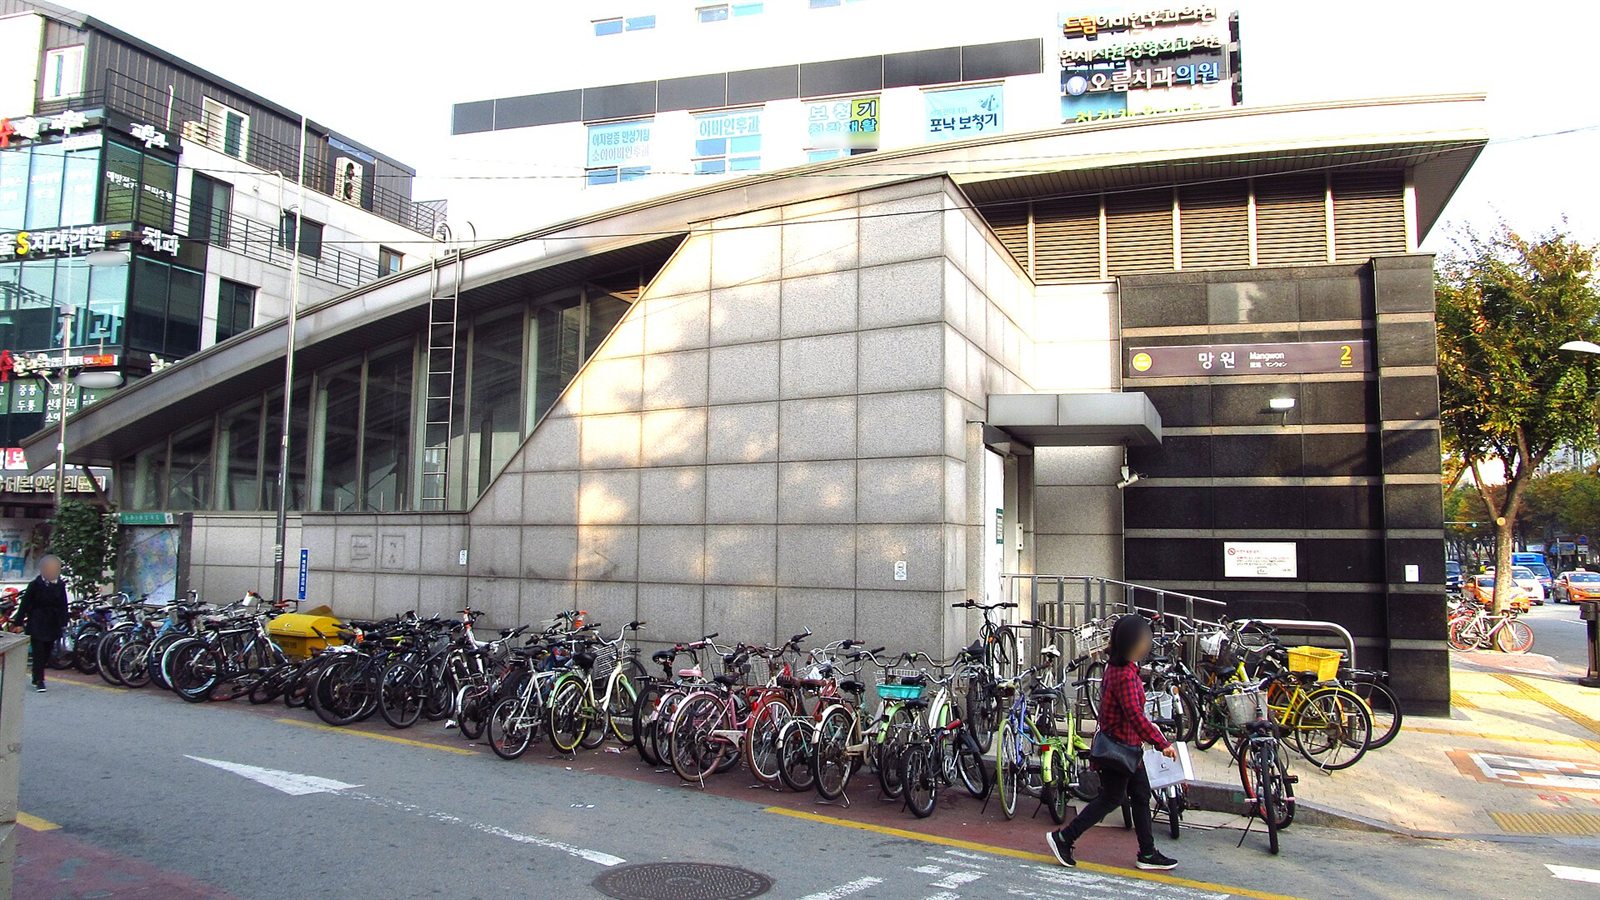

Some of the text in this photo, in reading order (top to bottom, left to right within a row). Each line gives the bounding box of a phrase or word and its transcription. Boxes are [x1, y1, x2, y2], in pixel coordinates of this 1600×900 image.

[1089, 62, 1219, 92] 오름치과의원
[700, 115, 760, 136] 이비인후과
[930, 113, 998, 132] 포낙 보청기
[1249, 352, 1284, 362] Mangwon
[1340, 345, 1352, 361] 2
[19, 384, 36, 397] 중풍
[17, 399, 36, 411] 두통
